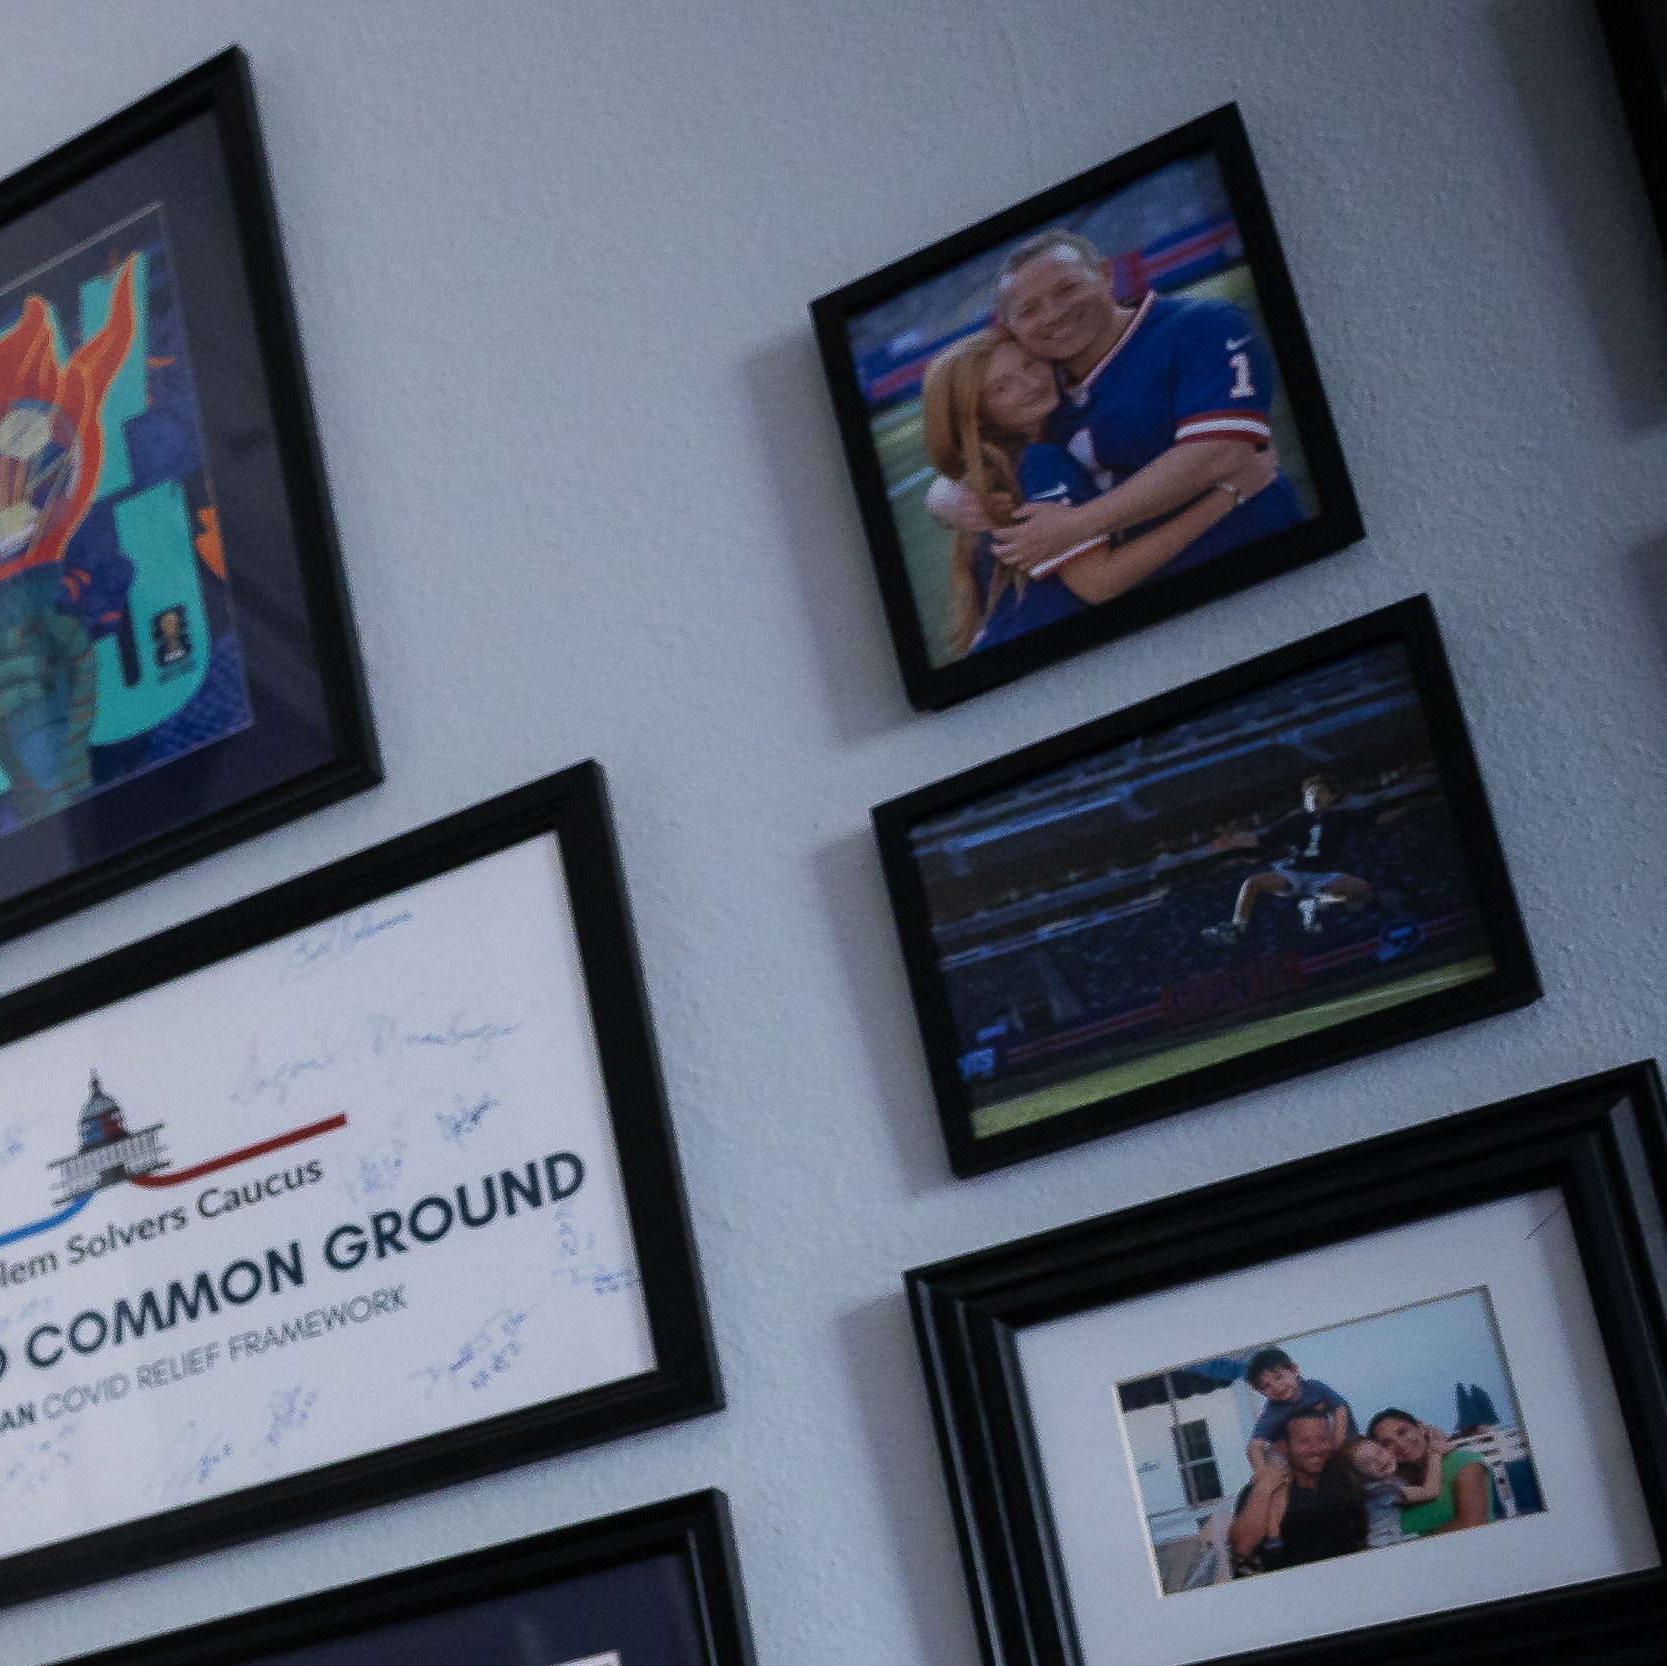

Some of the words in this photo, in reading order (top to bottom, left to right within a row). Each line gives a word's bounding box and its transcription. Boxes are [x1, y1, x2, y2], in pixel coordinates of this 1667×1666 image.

[23, 1238, 305, 1372] COMMON
[323, 1149, 587, 1273] GROUND
[66, 1199, 189, 1267] Solvers
[195, 1157, 325, 1223] Caucus
[43, 1368, 132, 1422] COVID
[136, 1341, 221, 1394] RELIEF
[228, 1284, 408, 1363] FRAMEWORK
